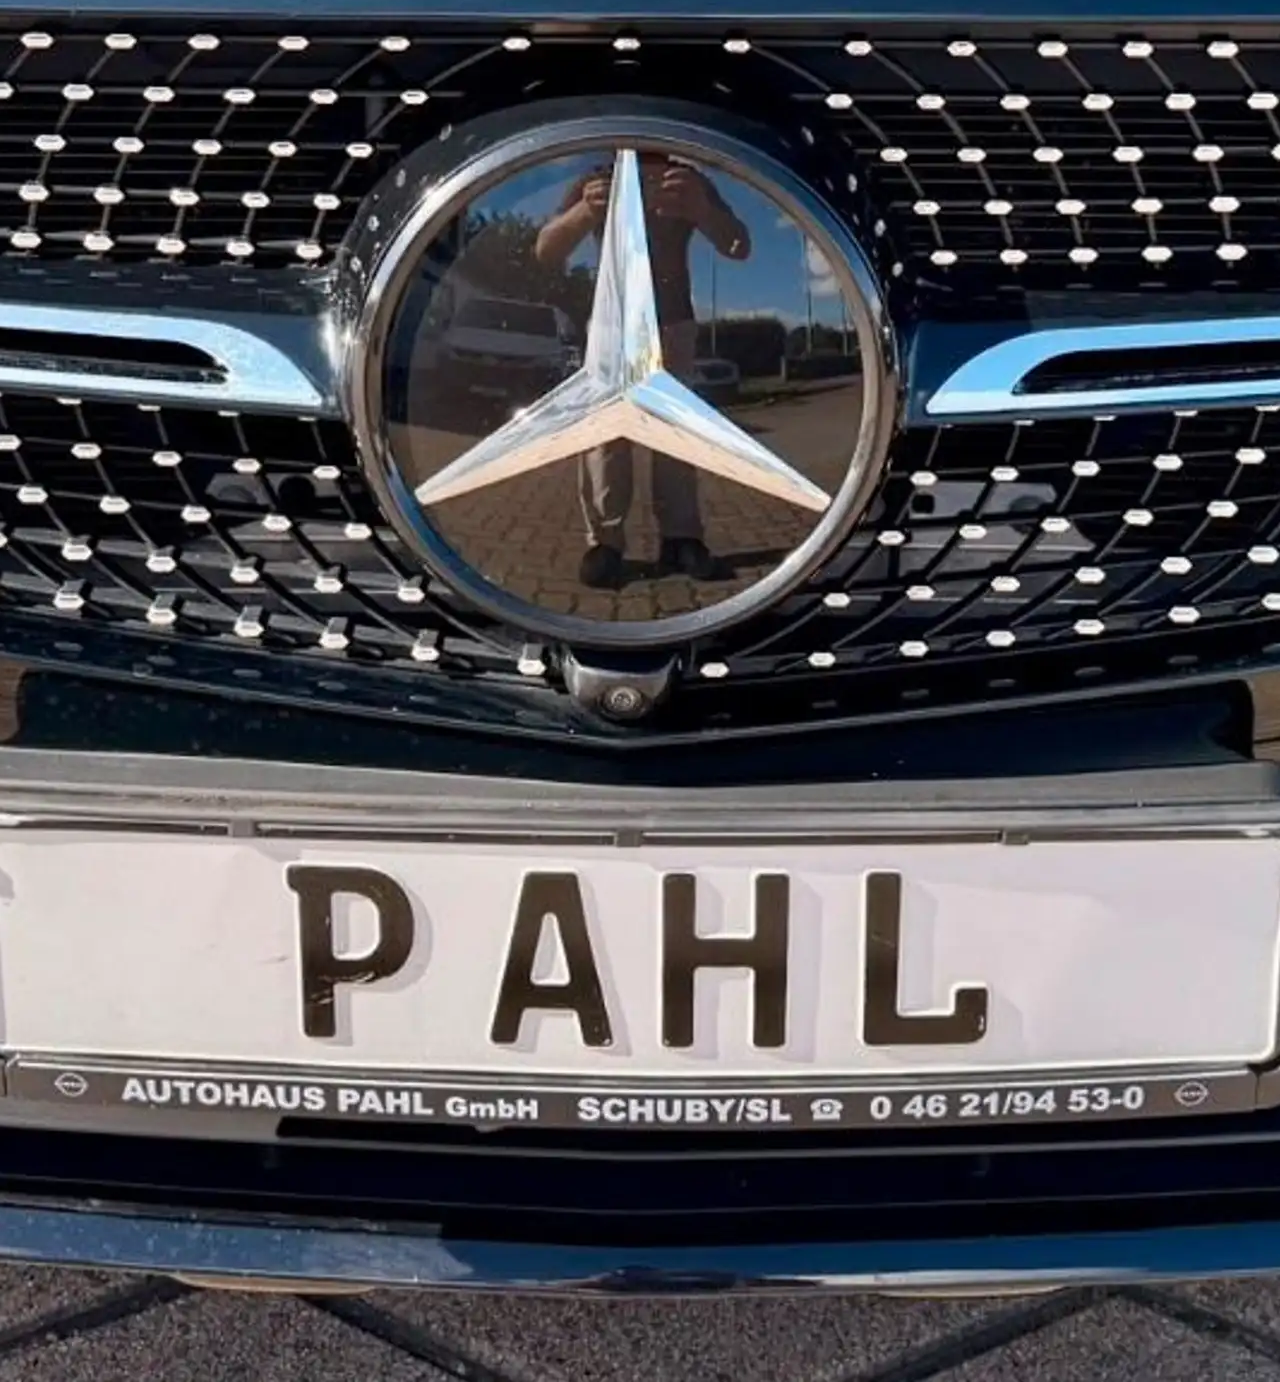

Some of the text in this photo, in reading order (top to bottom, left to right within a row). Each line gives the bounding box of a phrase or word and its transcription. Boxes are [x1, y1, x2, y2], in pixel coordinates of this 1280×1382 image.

[287, 864, 989, 1048] PAHL
[121, 1077, 1145, 1122] AUTOHAUS PAHL GmbH SCHUBY/SL 0 46 21/94 53-0
